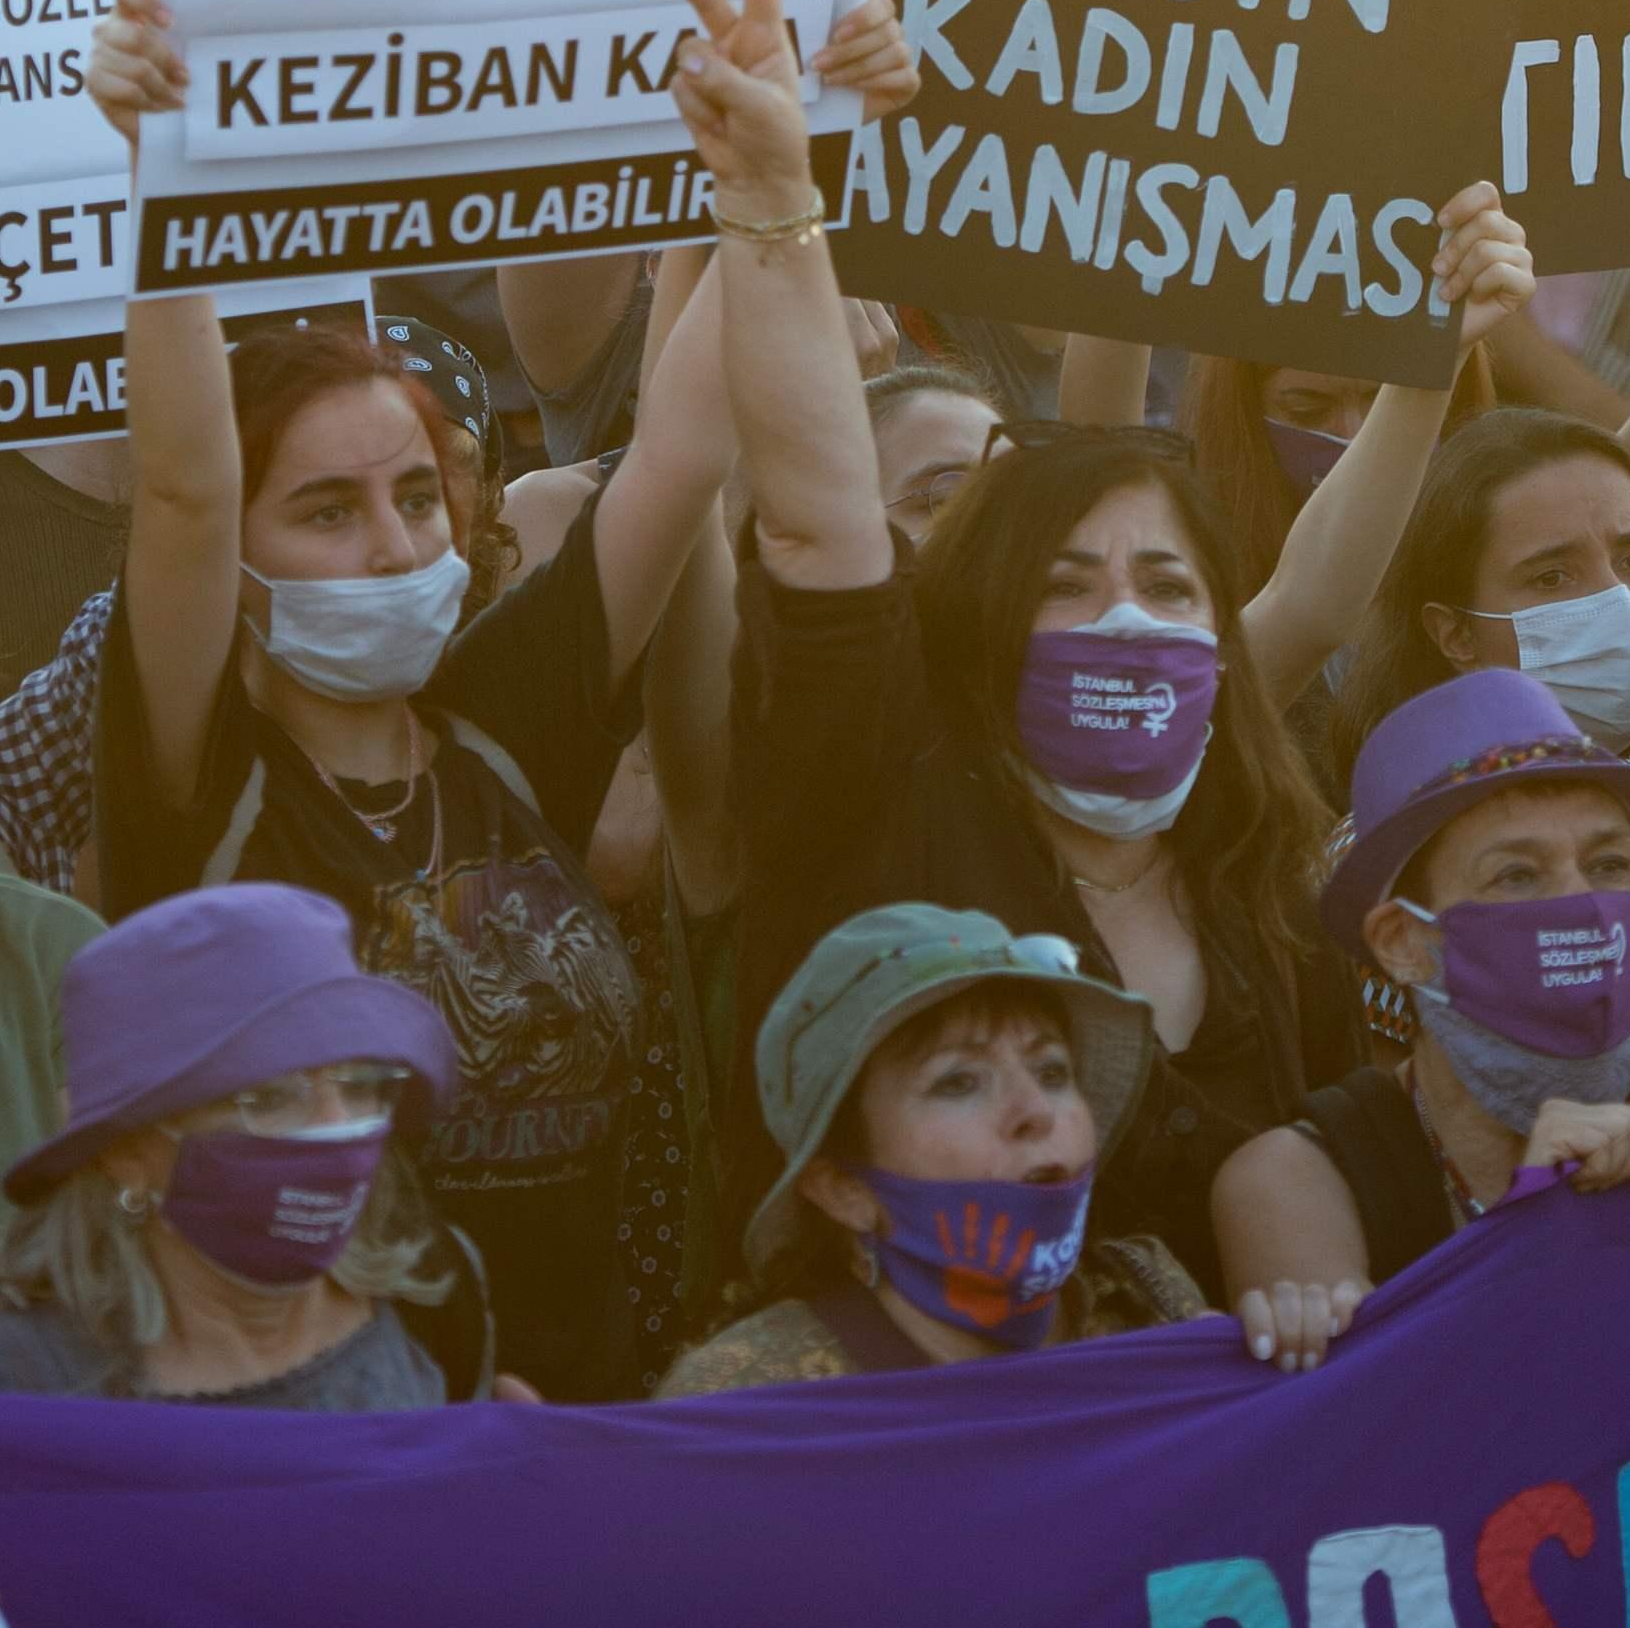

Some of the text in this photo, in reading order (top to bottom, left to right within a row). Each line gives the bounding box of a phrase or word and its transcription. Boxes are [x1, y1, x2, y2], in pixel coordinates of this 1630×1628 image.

[216, 32, 580, 131] KEZİBAN
[163, 200, 433, 272] HAYATTA
[1072, 672, 1136, 694] İSTANBUL
[1537, 928, 1607, 948] İSTANBUL
[1541, 968, 1604, 990] UYGULA!
